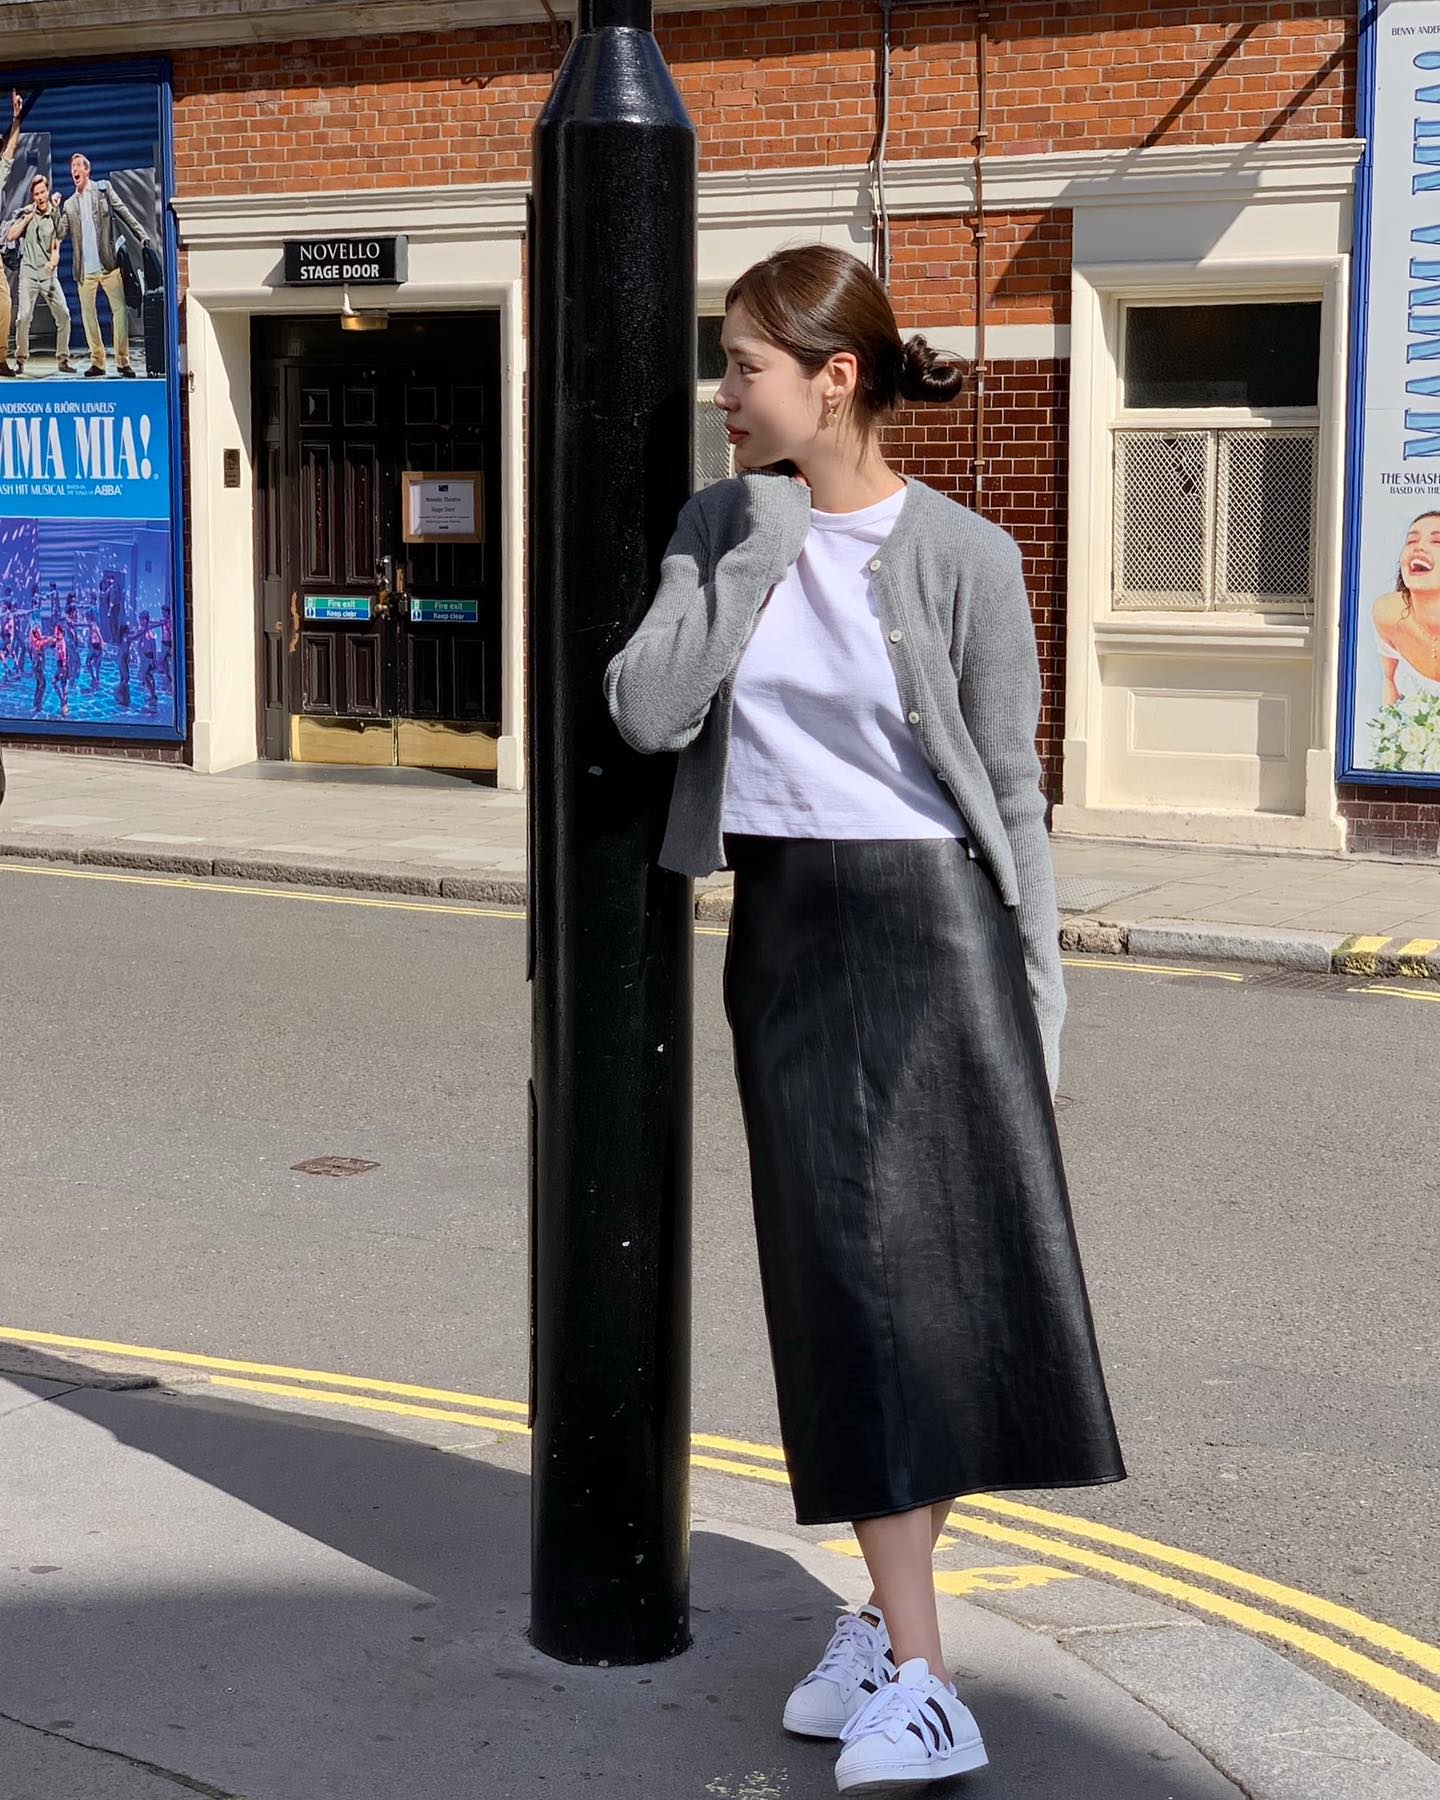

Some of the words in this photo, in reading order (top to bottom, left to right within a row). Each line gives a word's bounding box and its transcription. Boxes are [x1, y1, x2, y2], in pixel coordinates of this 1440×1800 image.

[1391, 27, 1416, 36] BENNY
[300, 242, 380, 261] NOVELLO
[300, 265, 340, 279] STAGE
[343, 264, 380, 278] DOOR
[45, 402, 52, 414] &
[54, 400, 80, 414] BJÖRN
[73, 414, 152, 480] MIA!
[1380, 472, 1401, 485] THE
[1404, 472, 1440, 485] SMASH
[15, 483, 29, 496] HIT
[31, 483, 66, 496] MUSICAL
[1390, 486, 1413, 495] BASED
[1414, 486, 1426, 495] ON
[327, 599, 342, 608] Fire
[342, 600, 356, 608] exit
[434, 601, 449, 610] Fire
[449, 602, 463, 610] exit
[326, 609, 342, 618] Keep
[342, 610, 358, 618] clear
[433, 612, 449, 620] Keep
[449, 612, 465, 620] clear
